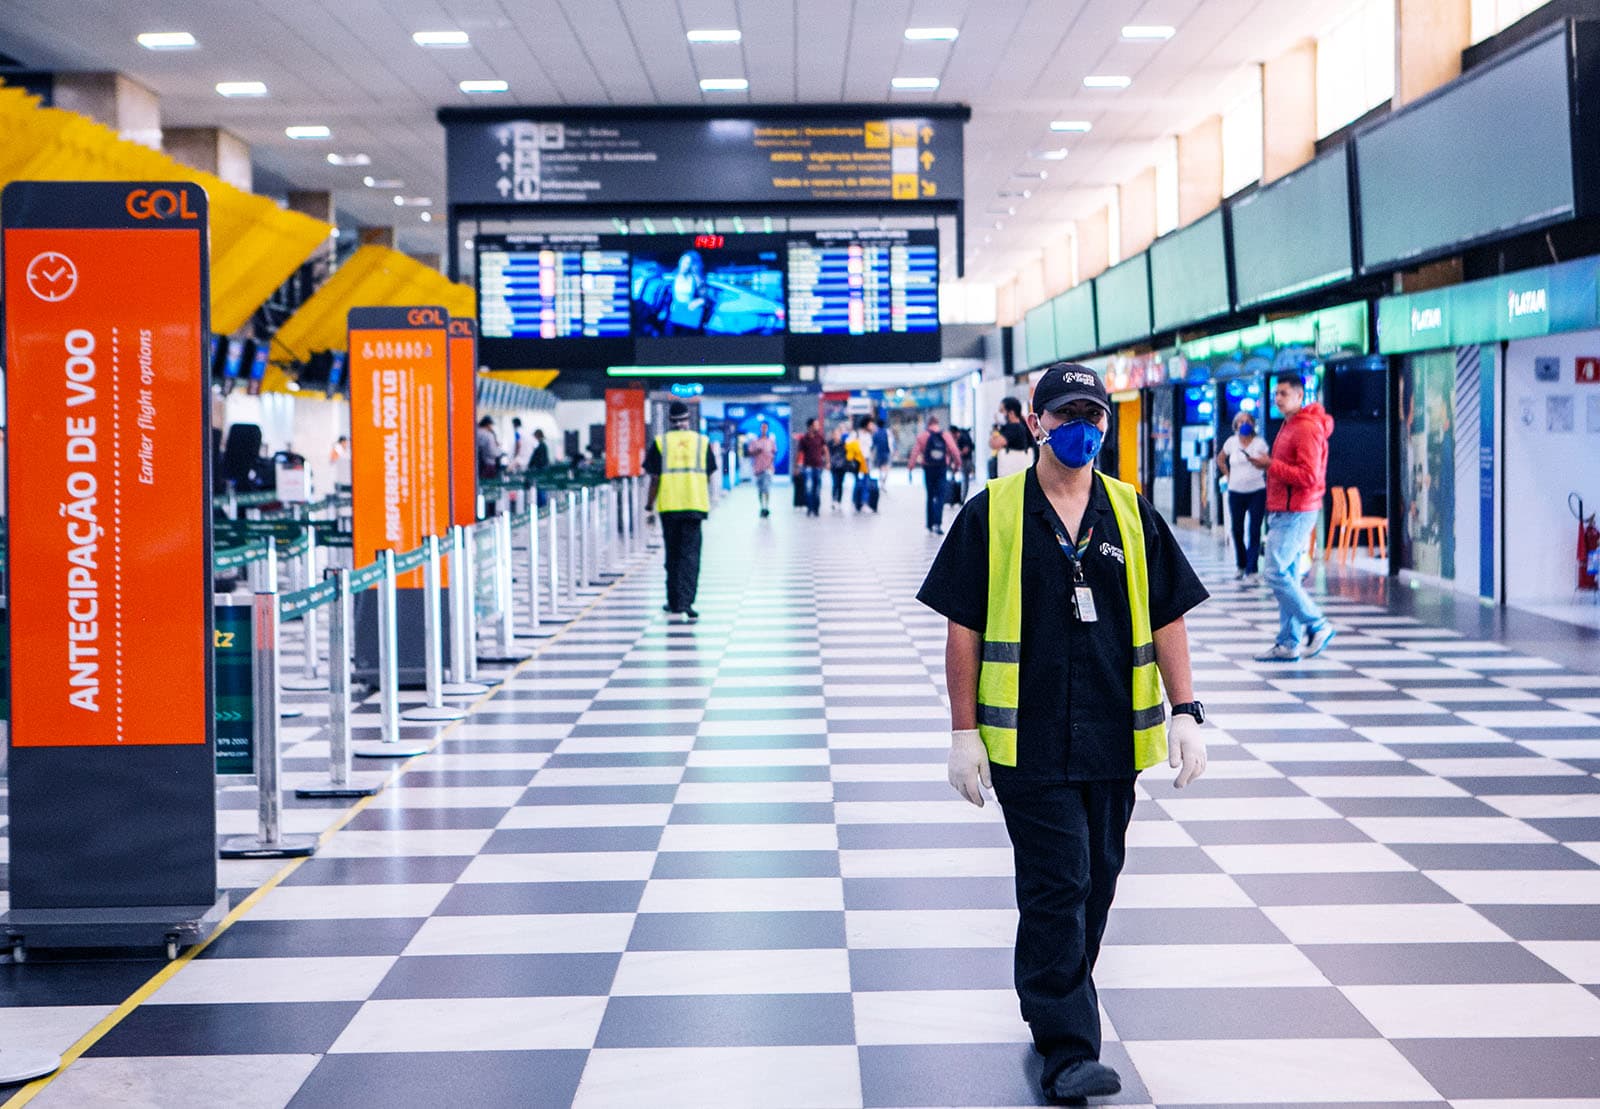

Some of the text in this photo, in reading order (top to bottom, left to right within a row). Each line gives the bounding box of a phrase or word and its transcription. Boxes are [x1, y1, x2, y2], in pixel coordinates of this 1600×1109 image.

[125, 189, 198, 220] GOL
[407, 308, 445, 326] GOL
[449, 321, 473, 336] OL
[137, 328, 156, 486] Earlier flight options
[382, 369, 401, 541] PREFERENCIAL POR LEI
[59, 329, 105, 713] ANTECIPAÇÃO DE VOO
[213, 630, 235, 648] tz
